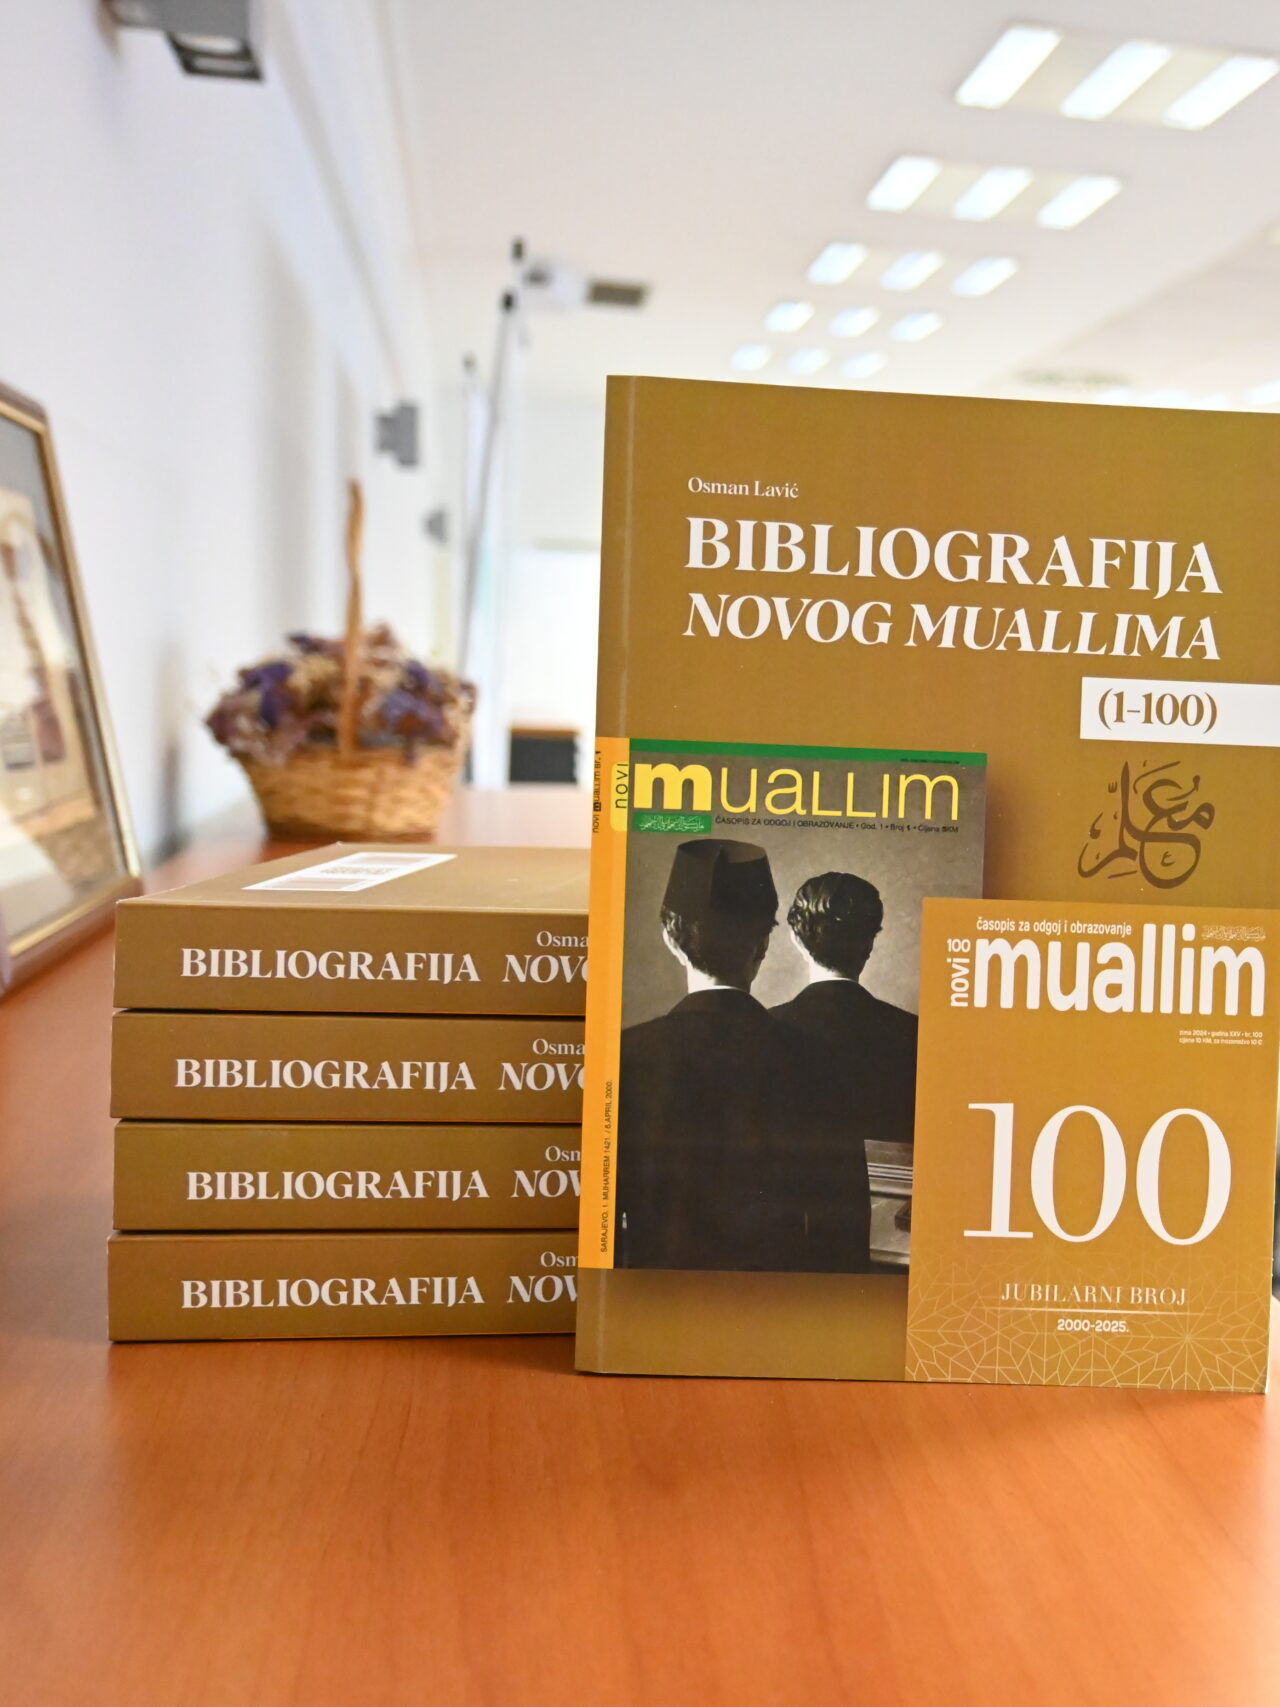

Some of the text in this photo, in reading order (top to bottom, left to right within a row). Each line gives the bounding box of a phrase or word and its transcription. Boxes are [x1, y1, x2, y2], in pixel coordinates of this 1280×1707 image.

[688, 477, 799, 498] Osman Lavić
[684, 516, 1223, 599] BIBLIOGRAFIJA
[682, 593, 1221, 661] NOVOG MUALLIMA
[1098, 687, 1218, 735] (1-100)
[715, 815, 749, 826] ČASOPIS
[751, 818, 761, 826] ZA
[797, 820, 855, 830] OBRAZOVANJE
[976, 916, 1015, 933] časopis
[1018, 920, 1031, 932] za
[1033, 919, 1061, 936] odgoj
[1070, 920, 1132, 936] obrazovanje
[946, 938, 971, 953] 100
[181, 948, 589, 985] BIBLIOGRAFIJA NOV
[946, 957, 970, 1007] novi
[974, 923, 1265, 1016] muallim
[175, 1058, 585, 1093] BIBLIOGRAFIJA NOV
[186, 1169, 489, 1202] BIBLIOGRAFIJA
[602, 1156, 610, 1201] MUHARREM
[963, 1102, 1232, 1246] 100
[181, 1275, 486, 1309] BIBLIOGRAFIJA
[1001, 1283, 1187, 1305] JUBILARNI BROJ
[1057, 1318, 1130, 1333] 2000-2025.
